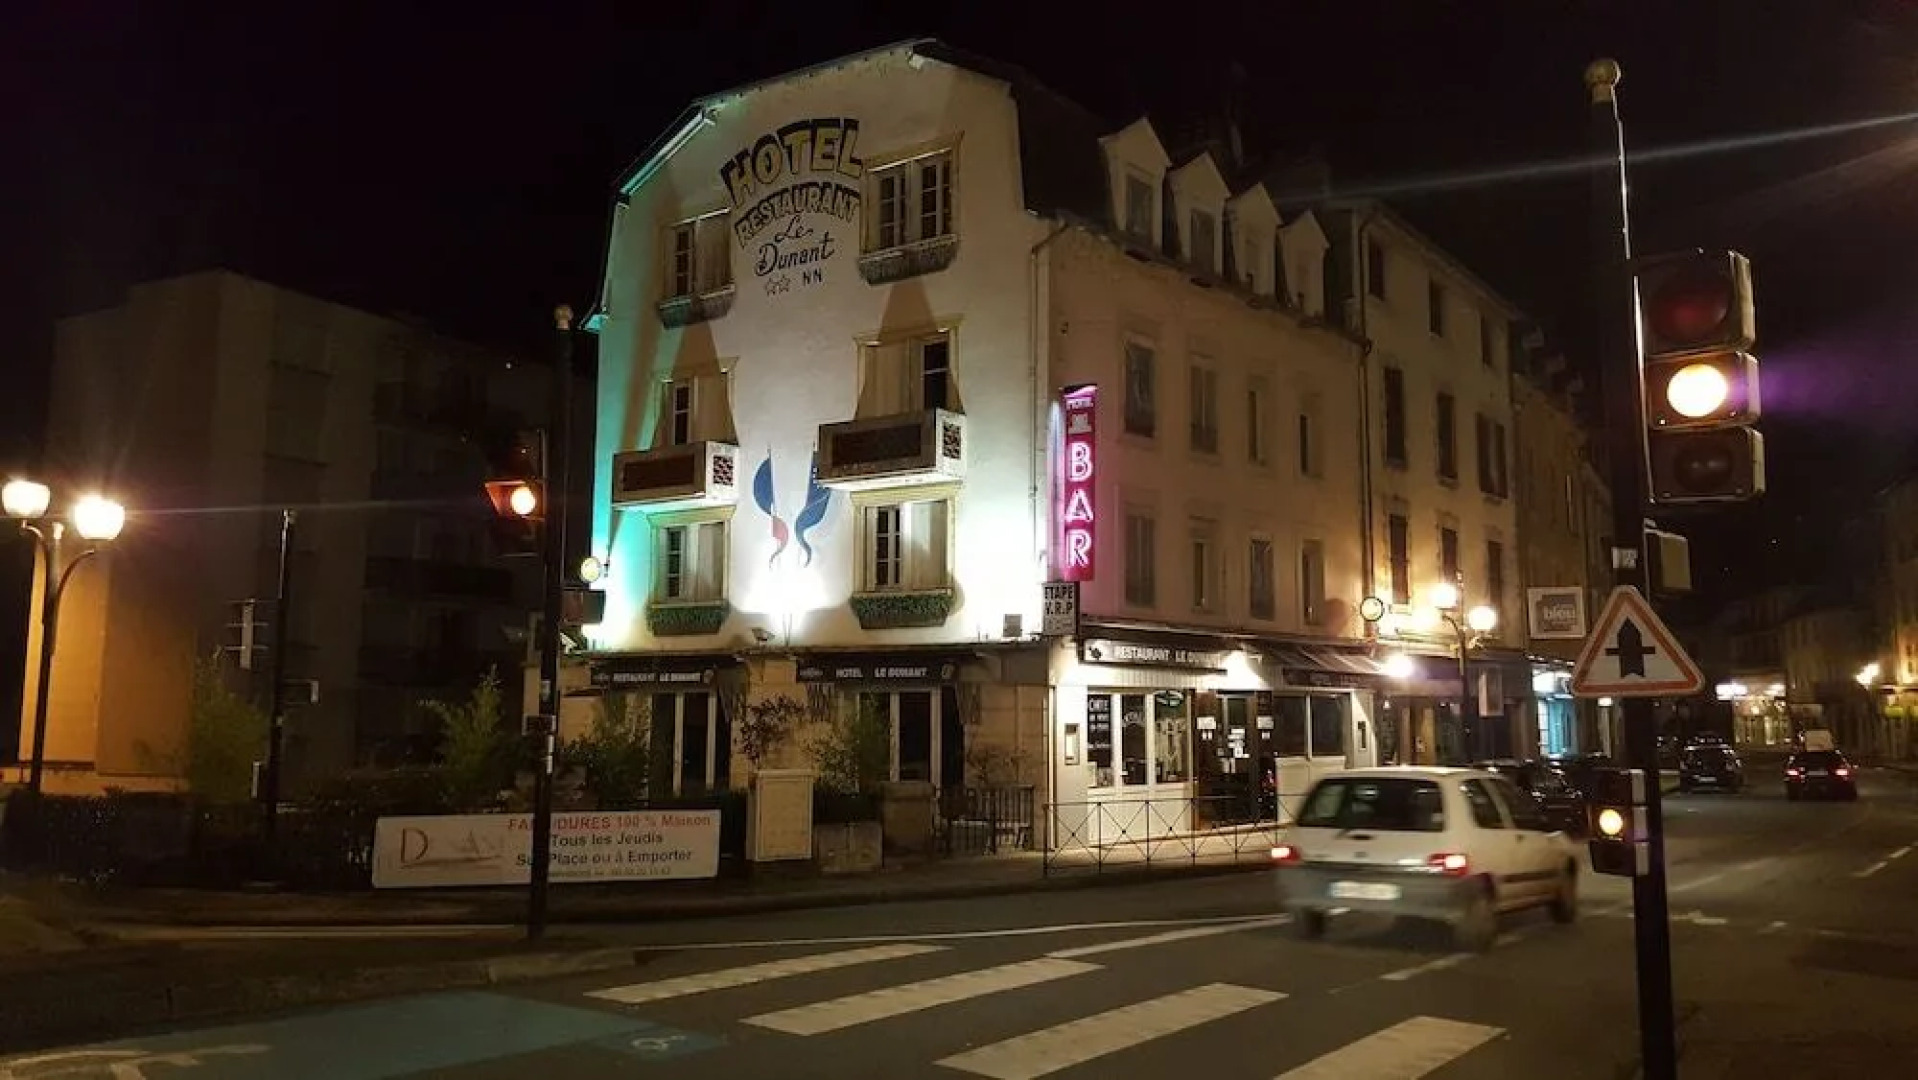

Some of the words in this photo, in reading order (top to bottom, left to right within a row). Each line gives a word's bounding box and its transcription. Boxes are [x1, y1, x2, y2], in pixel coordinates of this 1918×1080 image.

[721, 117, 863, 209] HOTEL
[734, 182, 861, 249] RESTAURANT
[774, 214, 814, 243] Le
[755, 231, 836, 277] Dunant
[802, 268, 822, 286] NN
[1065, 442, 1094, 567] BAR
[1114, 645, 1171, 661] RESTAURANT
[1174, 650, 1187, 663] LE
[836, 667, 863, 678] HOTEL
[875, 667, 887, 678] LE
[888, 666, 928, 678] DUNANT
[616, 813, 641, 829] 100
[552, 834, 587, 848] Tous
[592, 833, 613, 845] les
[618, 831, 663, 846] Jeudis
[592, 853, 611, 865] ou
[628, 848, 692, 864] Emporter
